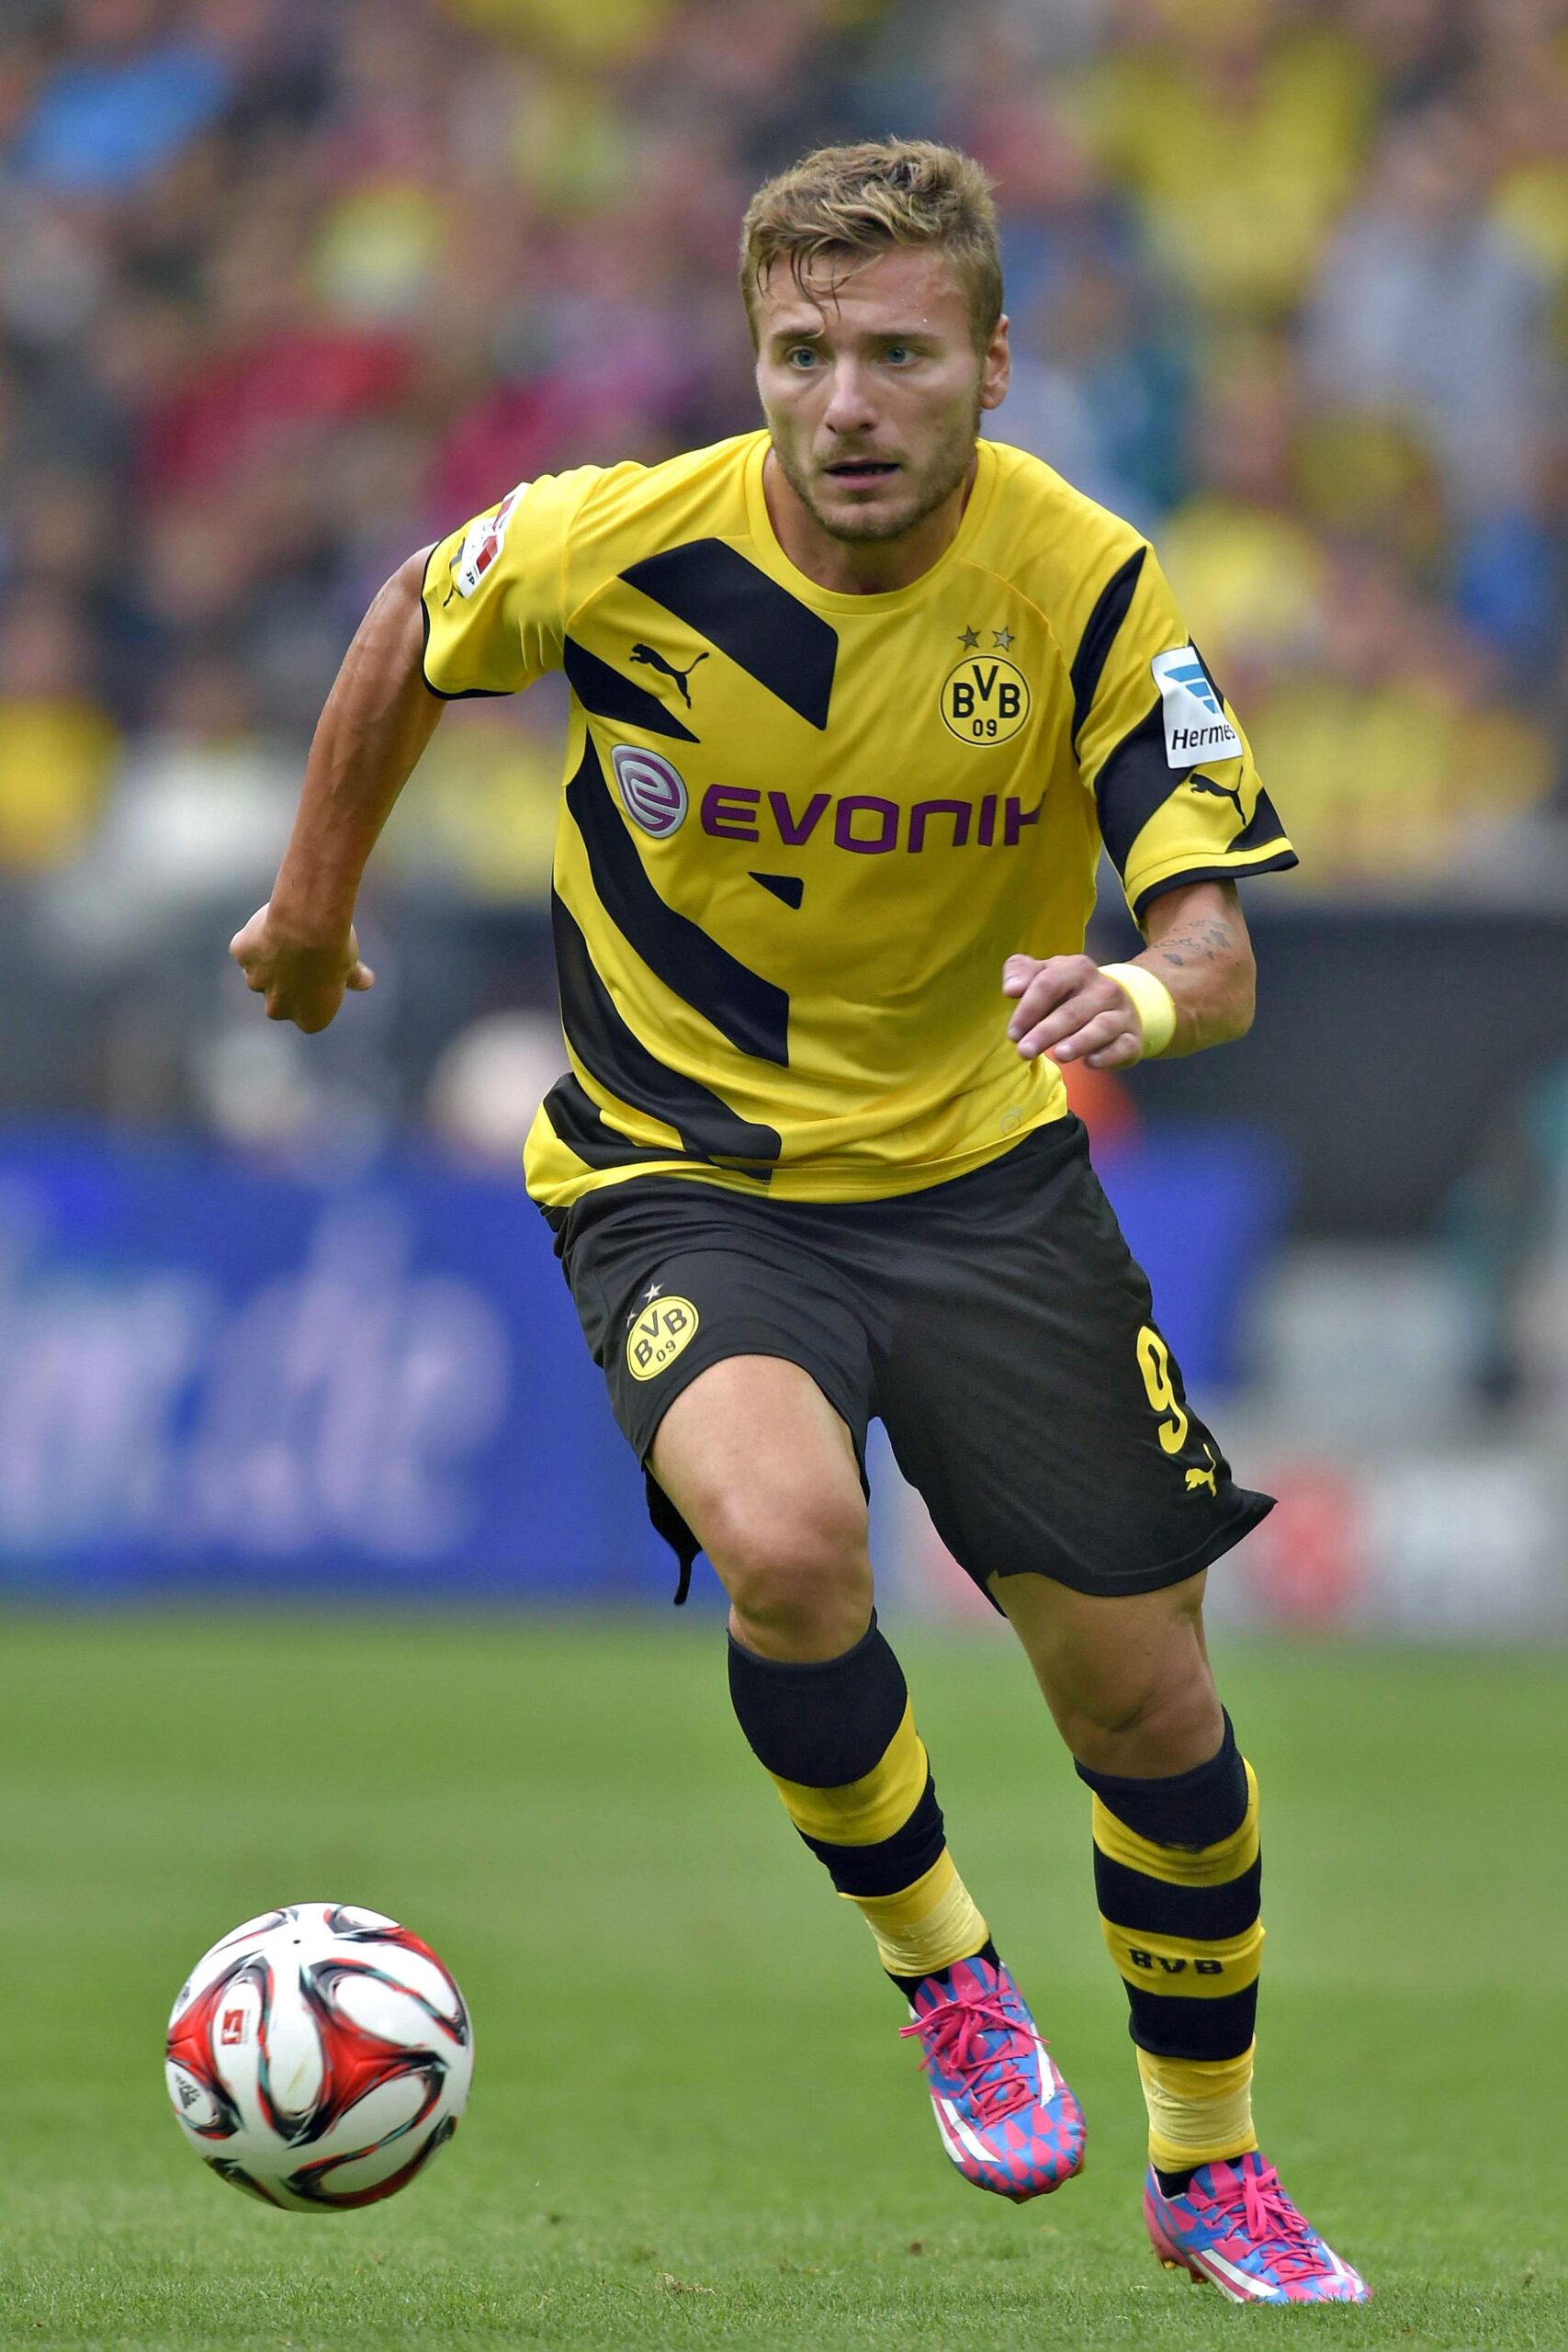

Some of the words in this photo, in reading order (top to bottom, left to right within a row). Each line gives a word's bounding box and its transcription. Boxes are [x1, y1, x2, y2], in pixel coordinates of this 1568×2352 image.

[953, 664, 1021, 719] BVB
[972, 719, 998, 737] 09
[634, 1308, 688, 1369] BVB
[656, 1340, 676, 1363] 09
[1136, 1325, 1188, 1454] 9
[1129, 1947, 1224, 1974] BVB
